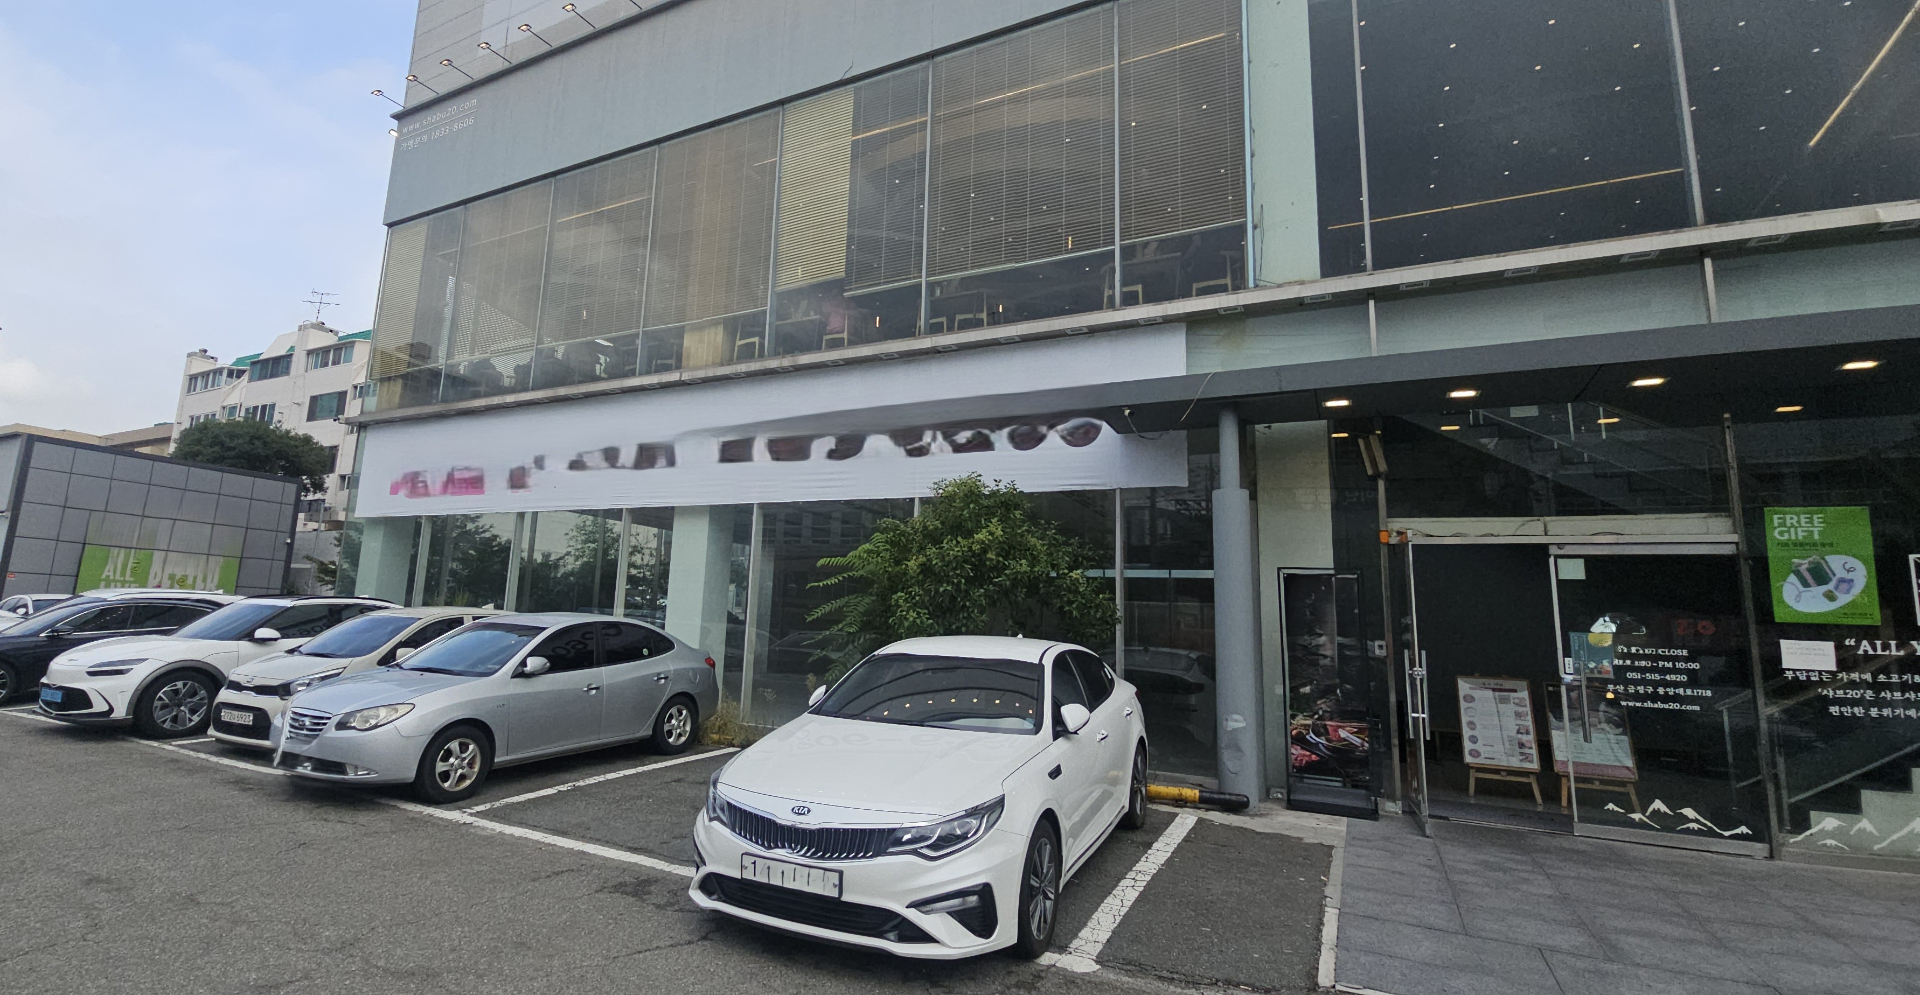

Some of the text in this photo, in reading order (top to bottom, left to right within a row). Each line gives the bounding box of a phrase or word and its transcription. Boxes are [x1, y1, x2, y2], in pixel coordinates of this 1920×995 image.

[402, 99, 477, 134] www.shabu20.com
[431, 116, 475, 140] 1833-8606
[1772, 514, 1826, 527] FREE
[1773, 527, 1824, 540] GIFT
[1626, 672, 1688, 681] 051-515-4920
[1783, 670, 1834, 682] 부담없는
[1837, 671, 1872, 682] 가격에
[1606, 684, 1625, 693] 부산
[1627, 685, 1654, 693] 금정구
[1620, 701, 1700, 711] www.shabu20.com
[1828, 705, 1920, 720] 편안한 분위기에
[793, 806, 808, 814] KIA
